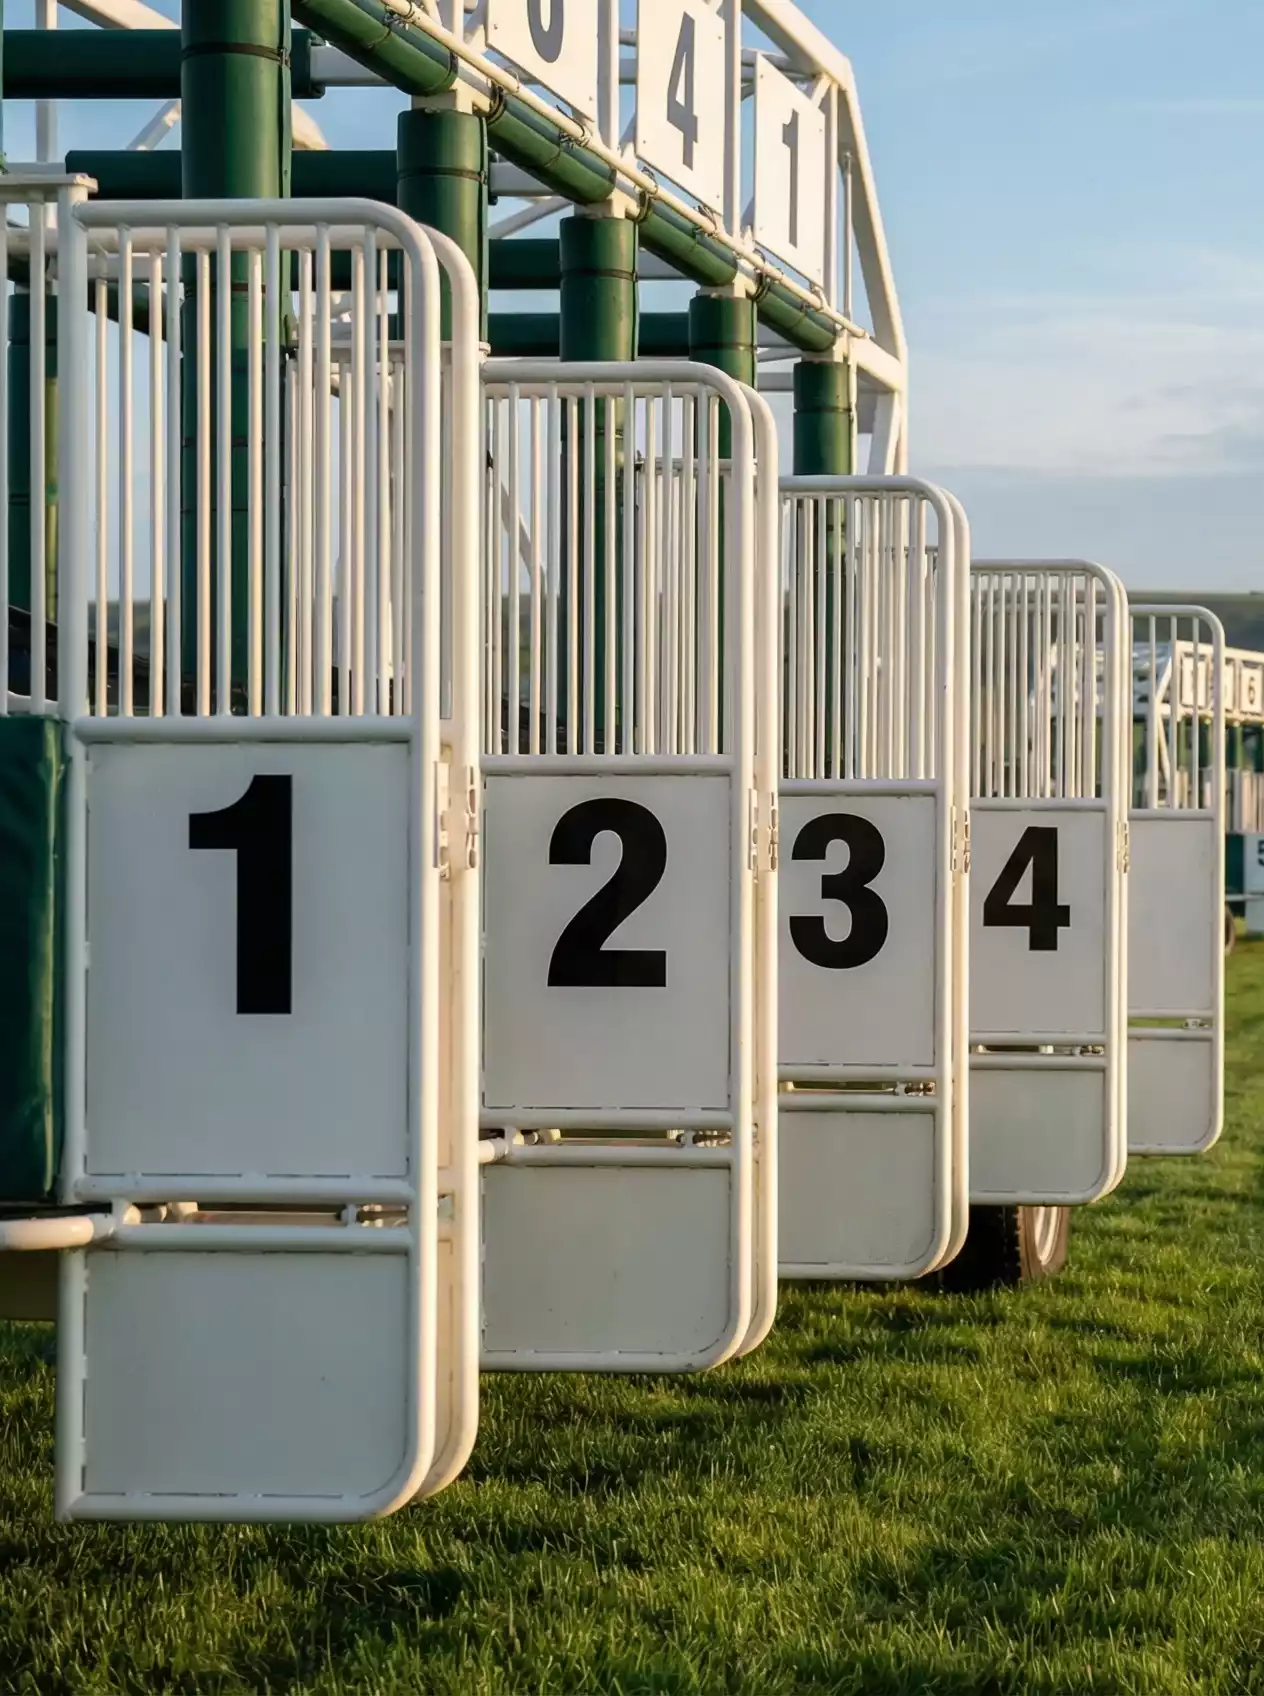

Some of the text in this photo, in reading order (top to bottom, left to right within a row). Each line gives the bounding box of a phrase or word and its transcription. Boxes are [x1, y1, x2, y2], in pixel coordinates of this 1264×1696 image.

[667, 11, 698, 171] 4
[782, 108, 799, 248] 1
[1247, 675, 1256, 706] 6
[188, 774, 293, 1015] 1
[547, 798, 667, 987] 2
[789, 813, 888, 969] 3
[982, 827, 1070, 951] 4
